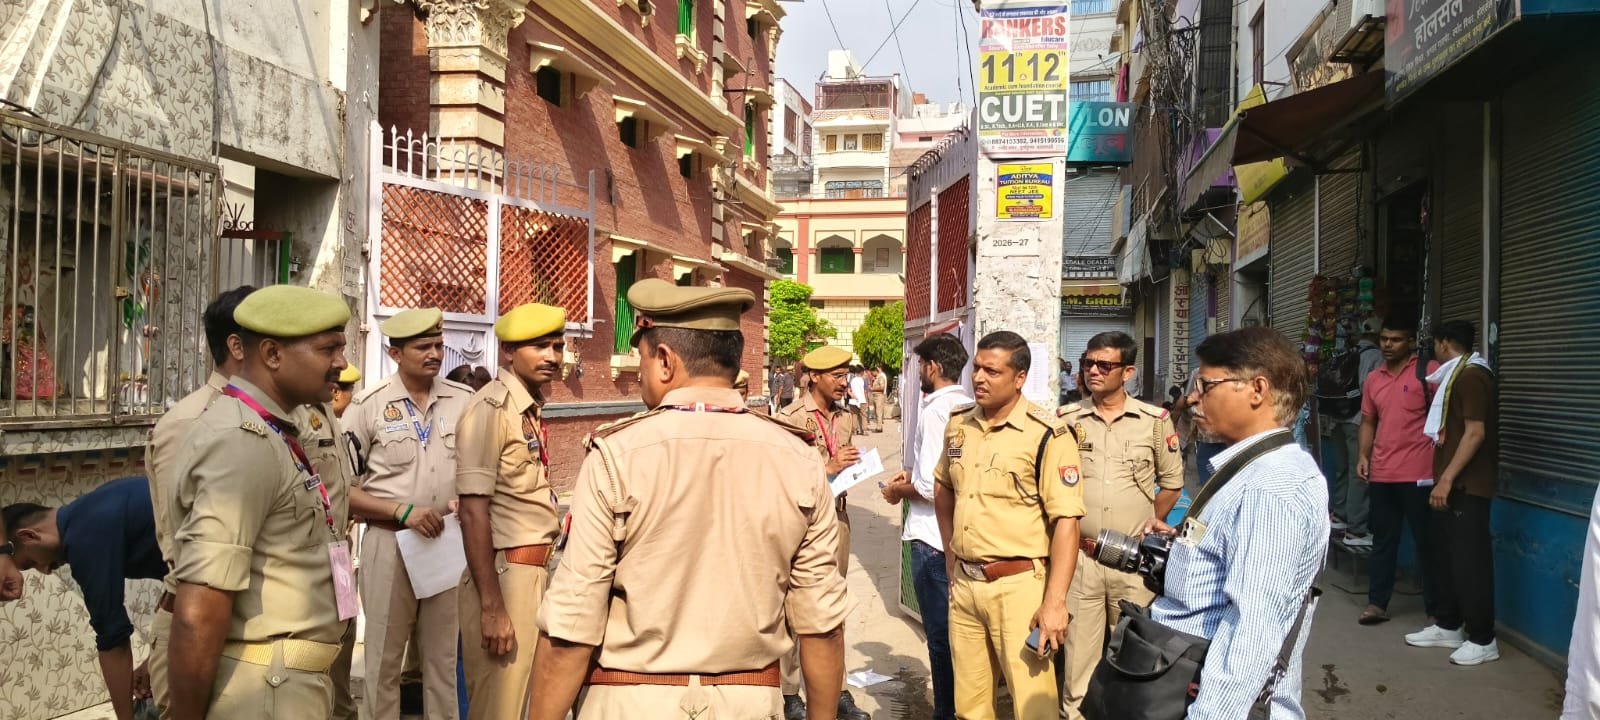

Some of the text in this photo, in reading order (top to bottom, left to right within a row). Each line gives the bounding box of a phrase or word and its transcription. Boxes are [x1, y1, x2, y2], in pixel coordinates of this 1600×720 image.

[982, 16, 1066, 38] RANKERS
[980, 95, 1064, 123] CUET
[999, 178, 1023, 186] TUITION
